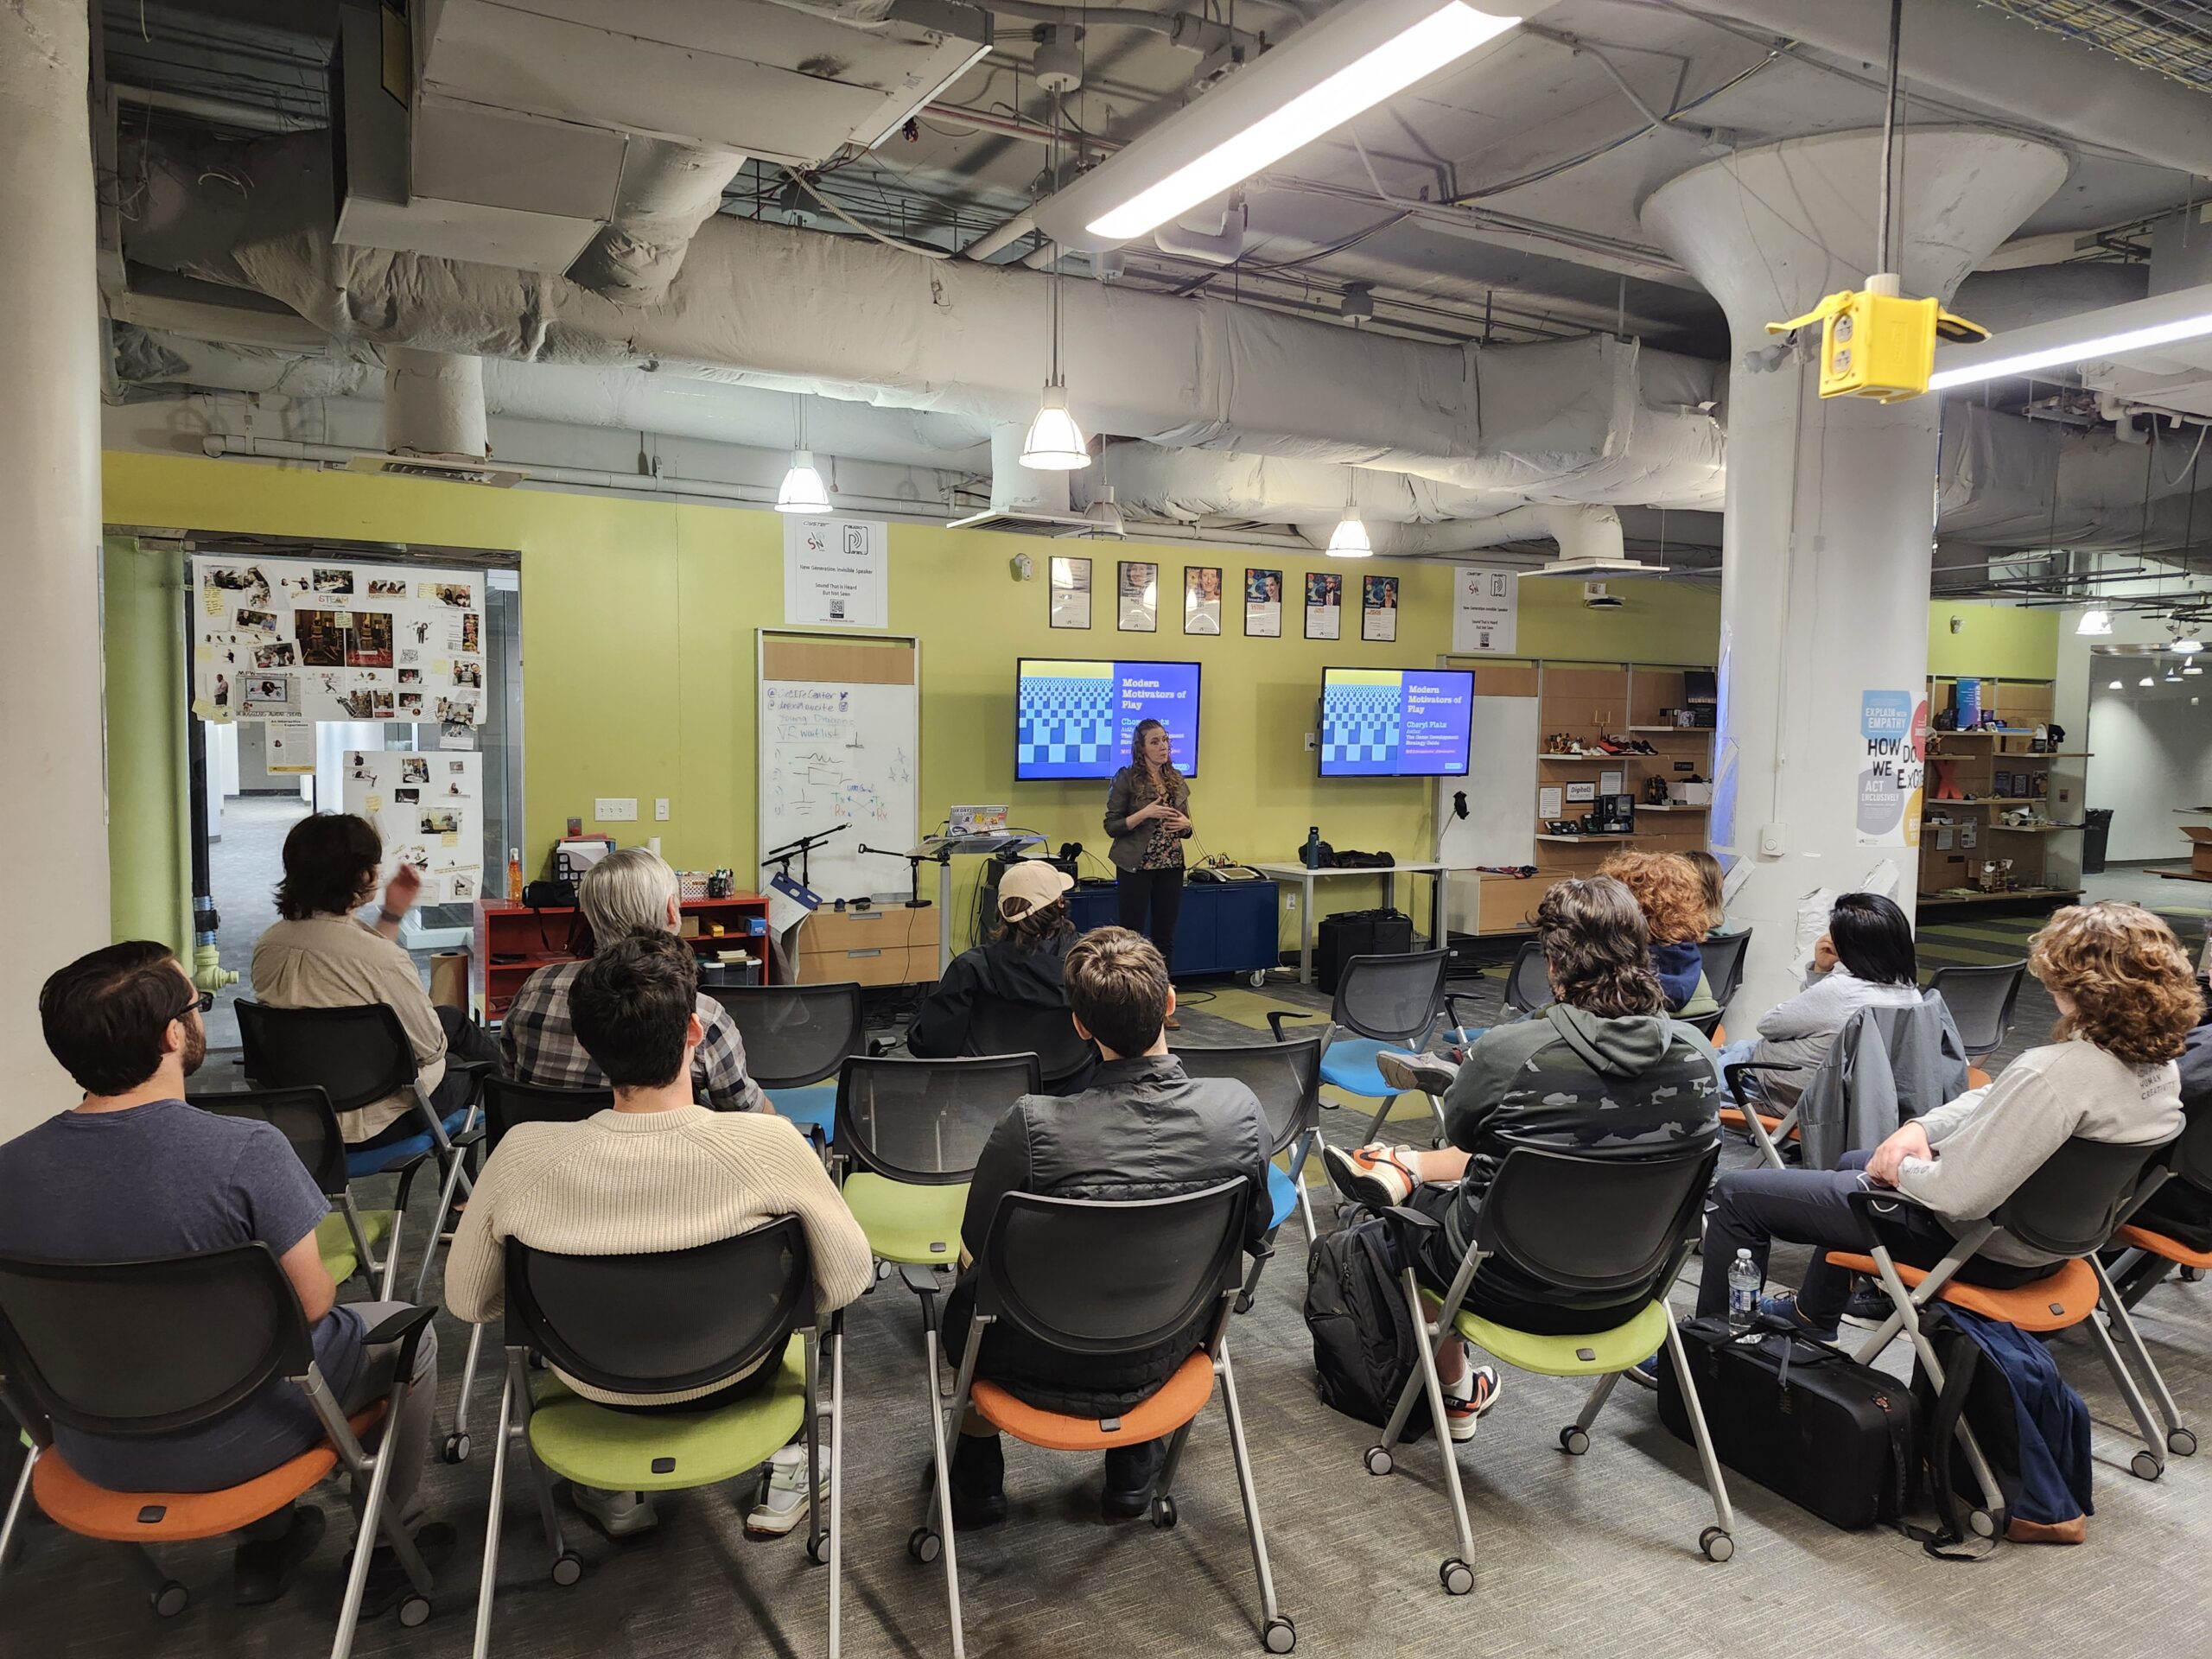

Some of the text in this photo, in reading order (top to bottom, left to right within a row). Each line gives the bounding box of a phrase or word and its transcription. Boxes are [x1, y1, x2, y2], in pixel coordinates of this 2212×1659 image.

[1122, 678, 1160, 688] Modern
[1122, 690, 1187, 699] Motivators of
[1409, 685, 1440, 694] Modern
[1122, 700, 1142, 710] Play
[1408, 705, 1425, 715] Play
[1866, 708, 1896, 717] EXPLAIN
[1407, 721, 1428, 729] Cheryl
[1868, 717, 1907, 728] EMPATHY
[1867, 737, 1917, 764] HOW DO
[1872, 760, 1892, 776] WE
[1865, 780, 1885, 792] ACT
[1861, 793, 1900, 802] INCLUSIVELY
[2139, 1073, 2162, 1089] HUMAN
